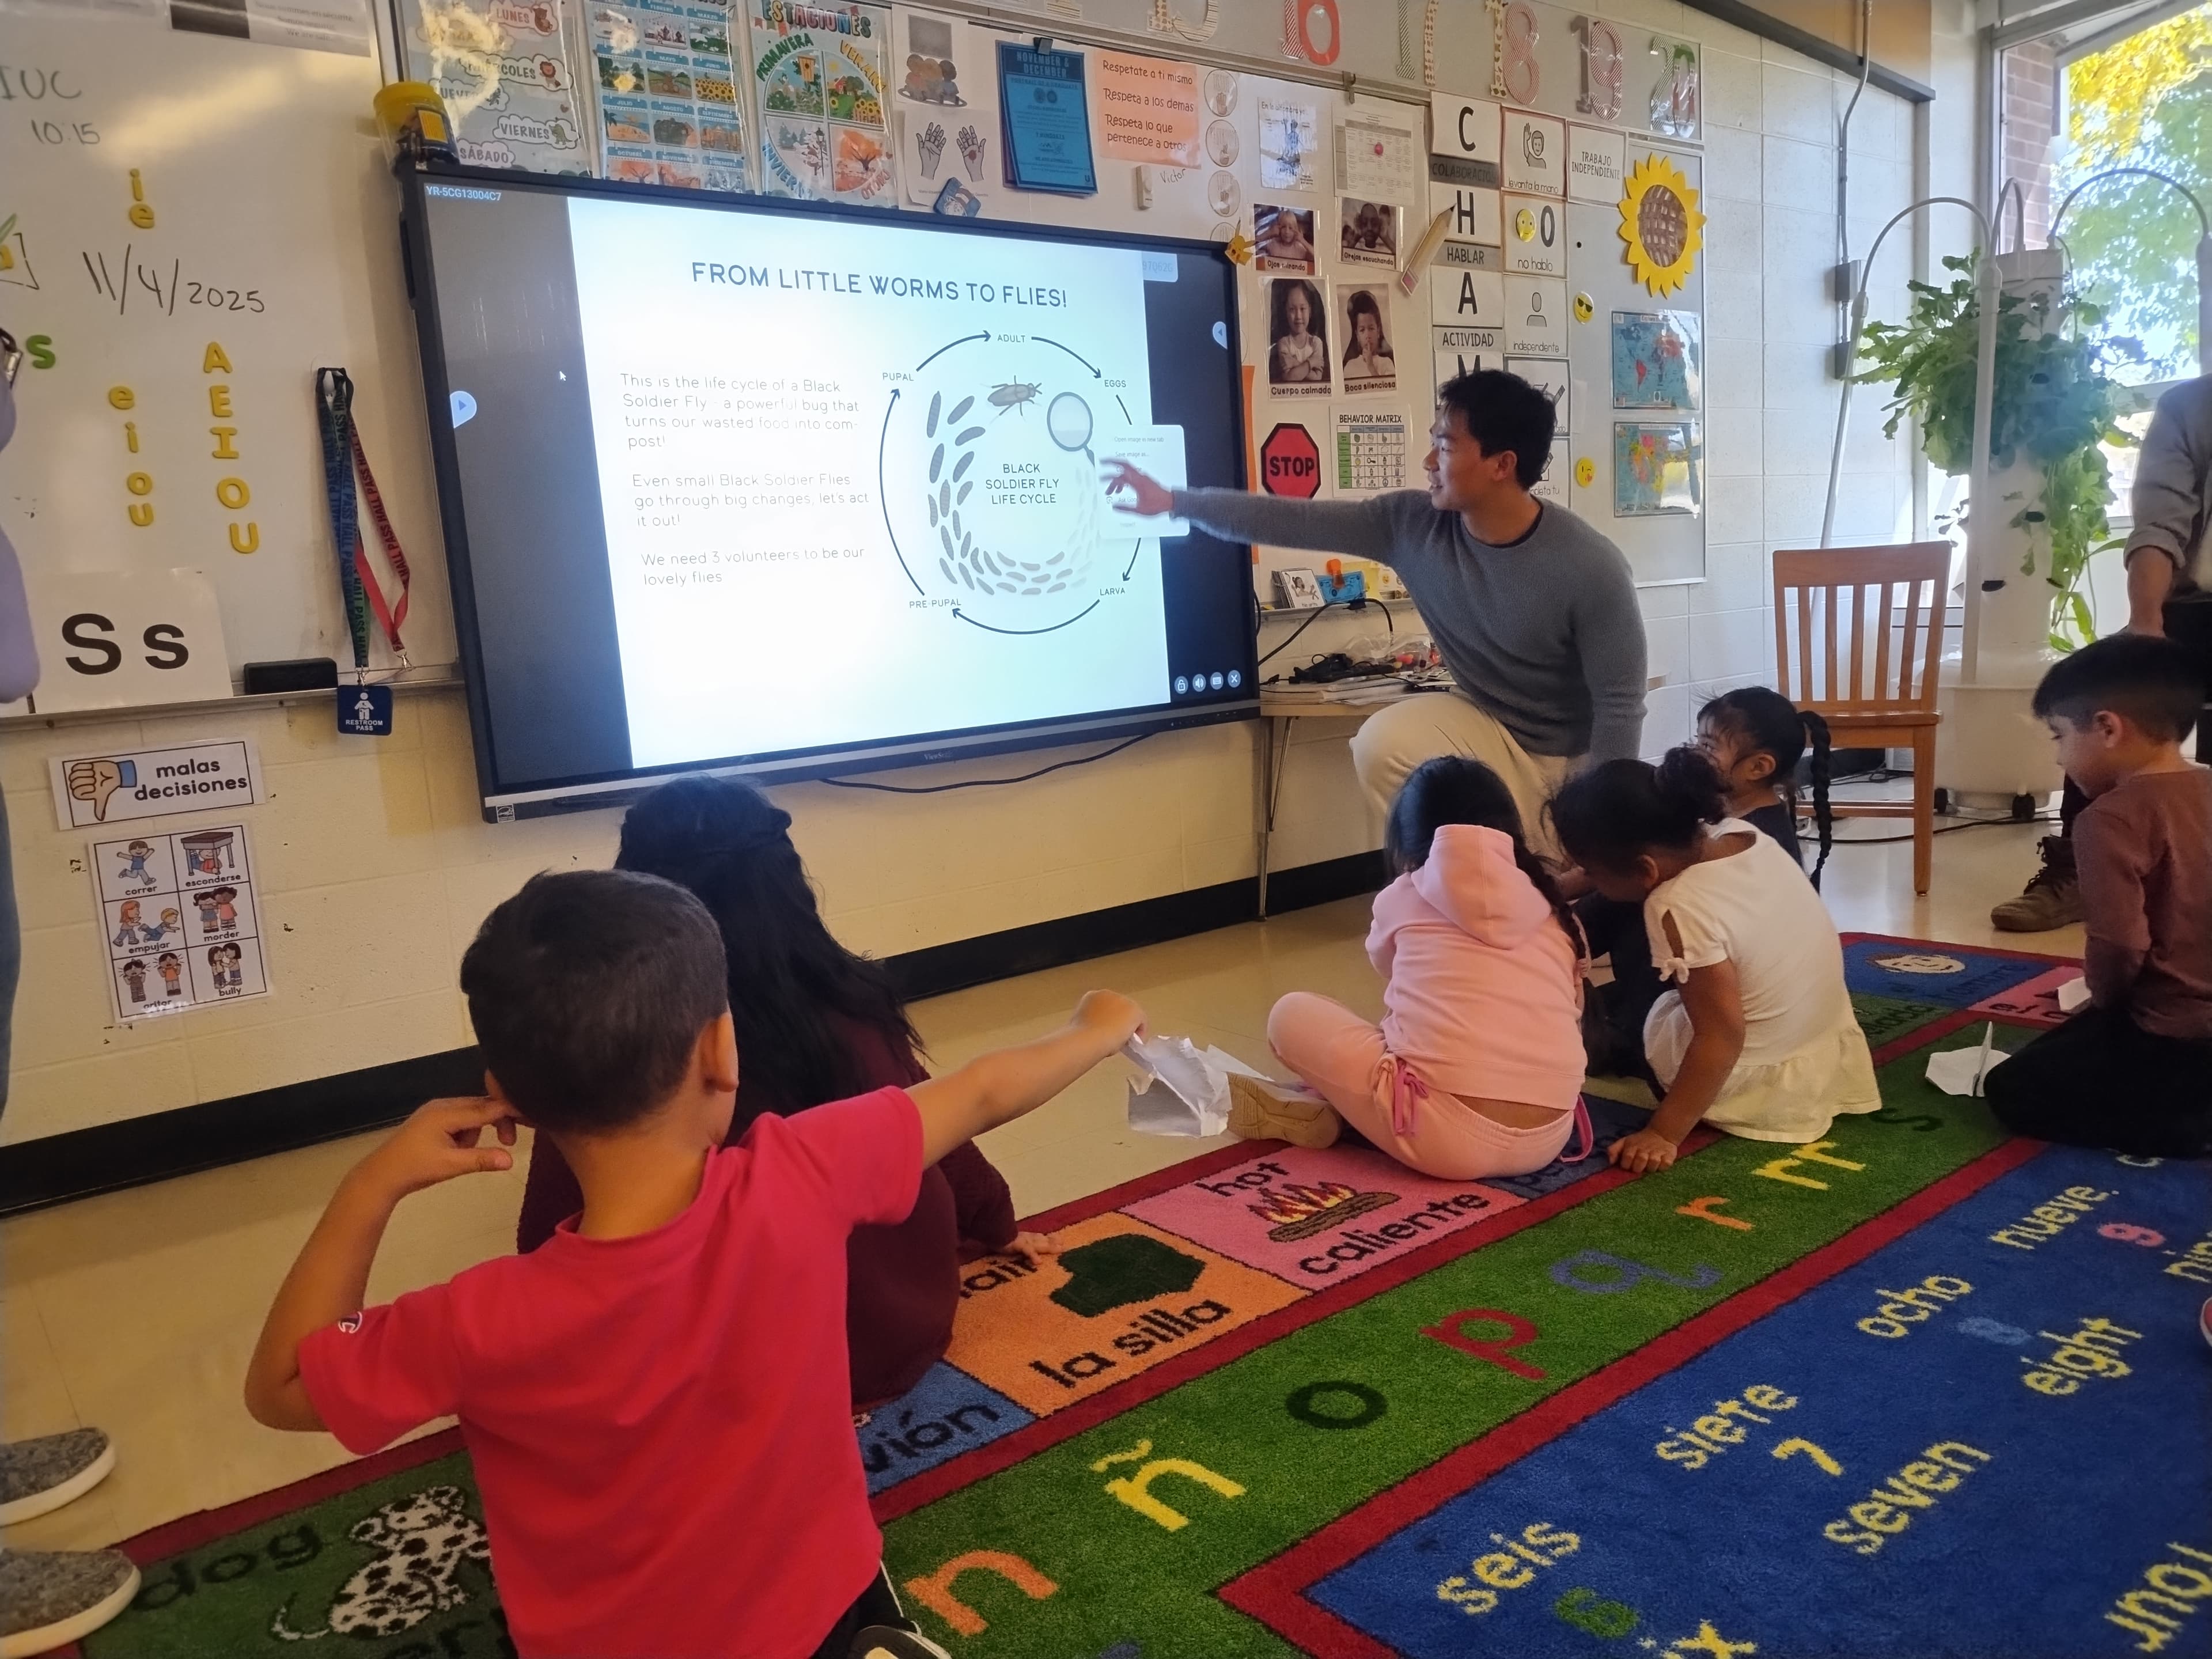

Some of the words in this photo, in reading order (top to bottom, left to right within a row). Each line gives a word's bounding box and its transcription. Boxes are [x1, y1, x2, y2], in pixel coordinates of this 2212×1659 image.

[497, 8, 530, 24] LUNES
[762, 0, 872, 38] ESTACIONES
[756, 33, 814, 82] PRIMAVERA
[1016, 50, 1061, 67] NOVEMBER
[1484, 0, 1540, 105] 18
[839, 39, 887, 93] VERANO
[1023, 62, 1067, 79] DECEMBER
[1103, 59, 1148, 77] Respetate
[1158, 70, 1165, 81] ti
[1167, 73, 1193, 85] mismo
[1570, 15, 1623, 121] 19
[1650, 36, 1696, 138] 20
[1103, 88, 1142, 106] Respeta
[1152, 96, 1164, 107] los
[1166, 98, 1194, 112] demas
[499, 123, 550, 140] VIERNES
[1105, 113, 1142, 132] Respeta
[1145, 121, 1154, 131] lo
[1156, 124, 1173, 135] que
[1458, 106, 1476, 151] C
[1107, 132, 1153, 148] pertenece
[1156, 140, 1161, 149] a
[1164, 141, 1186, 151] otros
[459, 145, 509, 163] SÁBADO
[1581, 150, 1612, 166] TRABAJO
[1160, 167, 1186, 184] Victor
[1571, 161, 1621, 180] INDEPENDIENTE
[1508, 177, 1533, 190] levanta
[1533, 180, 1540, 191] la
[1540, 183, 1559, 195] mano
[128, 203, 155, 229] e
[1456, 190, 1475, 236] H
[1267, 260, 1281, 269] Ojos
[1343, 252, 1361, 262] Orejas
[1446, 242, 1485, 266] HABLAR
[1517, 259, 1529, 269] no
[1531, 256, 1553, 272] hablo
[83, 244, 265, 316] 11/4/2025
[692, 262, 770, 287] FROM
[779, 268, 862, 294] LITTLE
[869, 275, 959, 301] WORMS
[966, 283, 995, 303] TO
[1003, 285, 1067, 308] FLIES!
[1457, 271, 1479, 316] A
[997, 334, 1026, 343] ADULT
[1442, 332, 1494, 347] ACTIVIDAD
[203, 341, 233, 374] A
[620, 373, 652, 388] This
[658, 376, 669, 388] is
[676, 376, 699, 389] the
[704, 376, 726, 389] life
[731, 378, 767, 392] cycle
[772, 379, 785, 391] of
[791, 382, 798, 392] a
[803, 379, 840, 392] Black
[882, 372, 915, 382] PUPAL
[1104, 379, 1127, 388] EGGS
[1345, 384, 1362, 392] Boca
[1363, 381, 1396, 391] silenciosa
[108, 385, 135, 410] e
[209, 385, 234, 417] E
[1271, 387, 1299, 397] Cuerpo
[1301, 385, 1331, 395] calmado
[623, 393, 679, 408] Soldier
[685, 395, 707, 411] Fly
[724, 400, 731, 409] a
[737, 398, 797, 412] powerful
[802, 399, 828, 415] bug
[833, 400, 859, 412] that
[625, 415, 666, 428] turns
[672, 418, 696, 428] our
[703, 416, 753, 429] wasted
[759, 415, 789, 429] food
[795, 418, 821, 430] into
[825, 420, 858, 430] com-
[1339, 414, 1374, 424] BEHAVIOR
[1376, 414, 1402, 423] MATRIX
[124, 421, 139, 453] i
[210, 427, 240, 459] I
[1003, 464, 1040, 474] BLACK
[1270, 456, 1315, 477] STOP
[632, 474, 669, 487] Even
[676, 474, 714, 487] small
[720, 474, 759, 487] Black
[764, 474, 814, 486] Soldier
[819, 474, 851, 486] Flies
[985, 479, 1036, 490] SOLDIER
[1039, 478, 1060, 489] FLY
[217, 477, 250, 509] O
[635, 497, 653, 510] go
[659, 494, 719, 509] through
[725, 494, 747, 508] big
[819, 491, 844, 503] let's
[849, 491, 869, 503] act
[991, 494, 1017, 505] LIFE
[1019, 494, 1057, 504] CYCLE
[638, 515, 647, 527] it
[229, 522, 260, 554] U
[641, 552, 665, 566] We
[671, 551, 707, 565] need
[711, 551, 720, 563] 3
[725, 550, 800, 563] volunteers
[805, 549, 818, 559] to
[823, 547, 839, 559] be
[843, 548, 865, 558] our
[644, 572, 687, 587] lovely
[692, 571, 723, 583] flies
[1099, 587, 1126, 597] LARVA
[60, 613, 123, 676] S
[142, 623, 190, 670] s
[156, 758, 221, 779] malas
[134, 775, 248, 802] decisiones
[125, 885, 157, 896] correr
[185, 873, 241, 888] esconderse
[128, 941, 171, 955] empujar
[204, 931, 240, 943] morder
[218, 986, 242, 997] bully
[1195, 1159, 1291, 1198] hot
[1675, 1195, 1757, 1233] r
[1988, 1185, 2110, 1251] nueve
[1298, 1189, 1492, 1280] caliente
[1858, 1272, 1974, 1339] ocho
[1029, 1350, 1118, 1389] la
[1113, 1296, 1233, 1358] silla
[1419, 1307, 1546, 1381] p
[2020, 1317, 2143, 1397] eight
[1655, 1382, 1798, 1470] siete
[1090, 1438, 1248, 1533] ñ
[1823, 1438, 1993, 1556] seven
[132, 1523, 321, 1611] dog
[1437, 1520, 1581, 1615] seis
